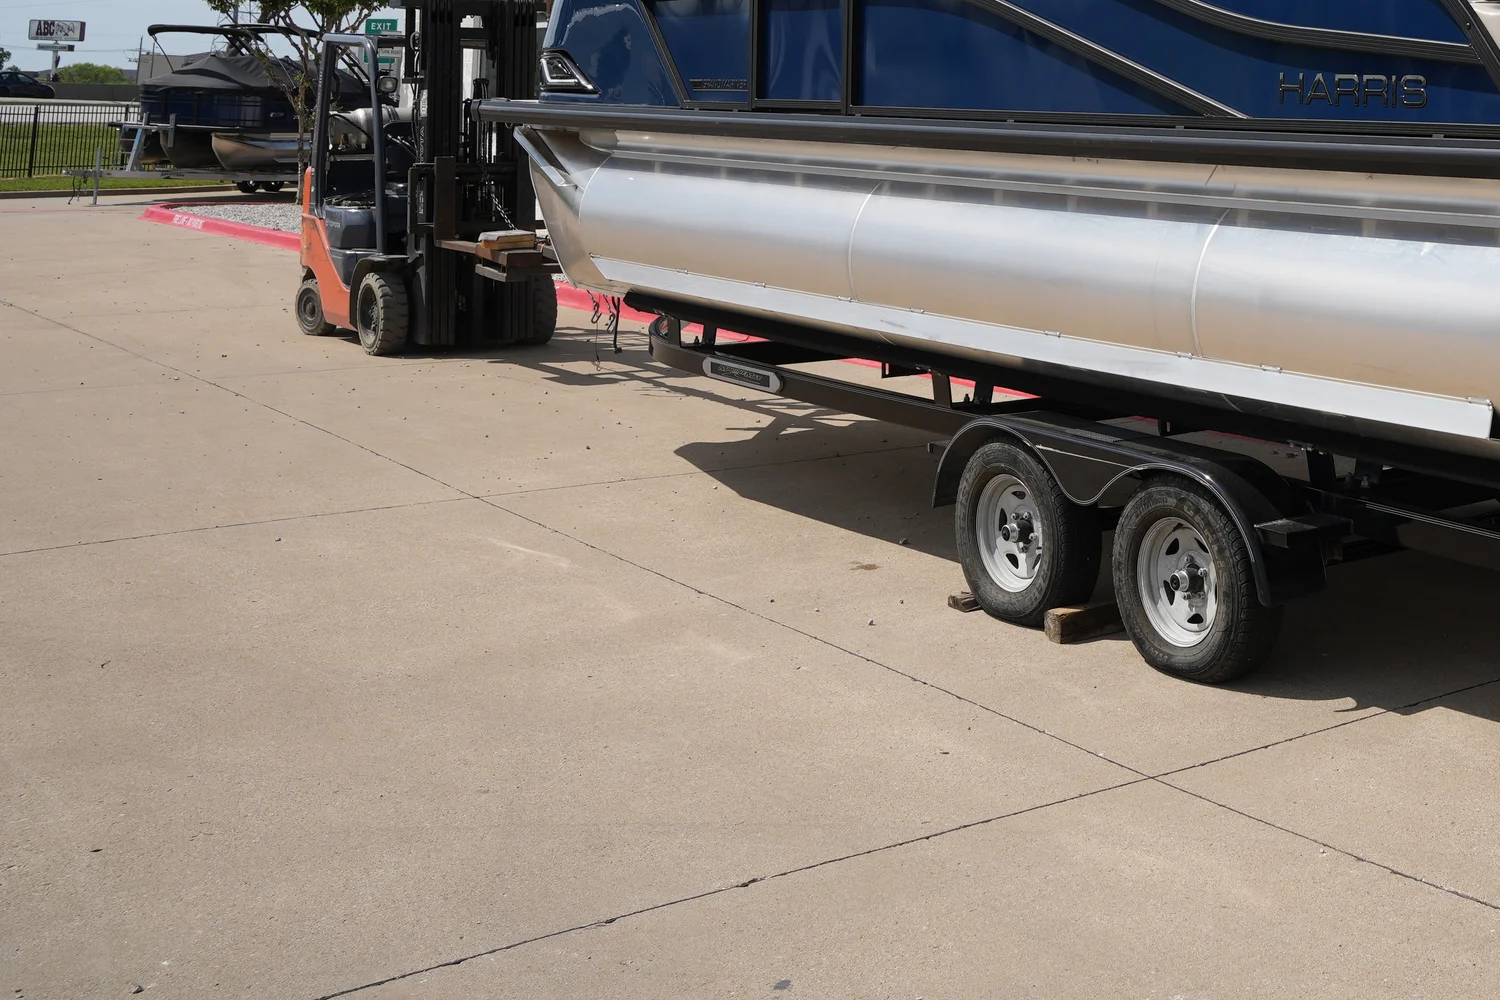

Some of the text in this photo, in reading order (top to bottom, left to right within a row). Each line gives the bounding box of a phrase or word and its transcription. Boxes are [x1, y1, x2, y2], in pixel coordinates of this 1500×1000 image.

[36, 20, 55, 36] ABC
[371, 22, 392, 30] EXIT
[1279, 72, 1427, 108] HARRIS
